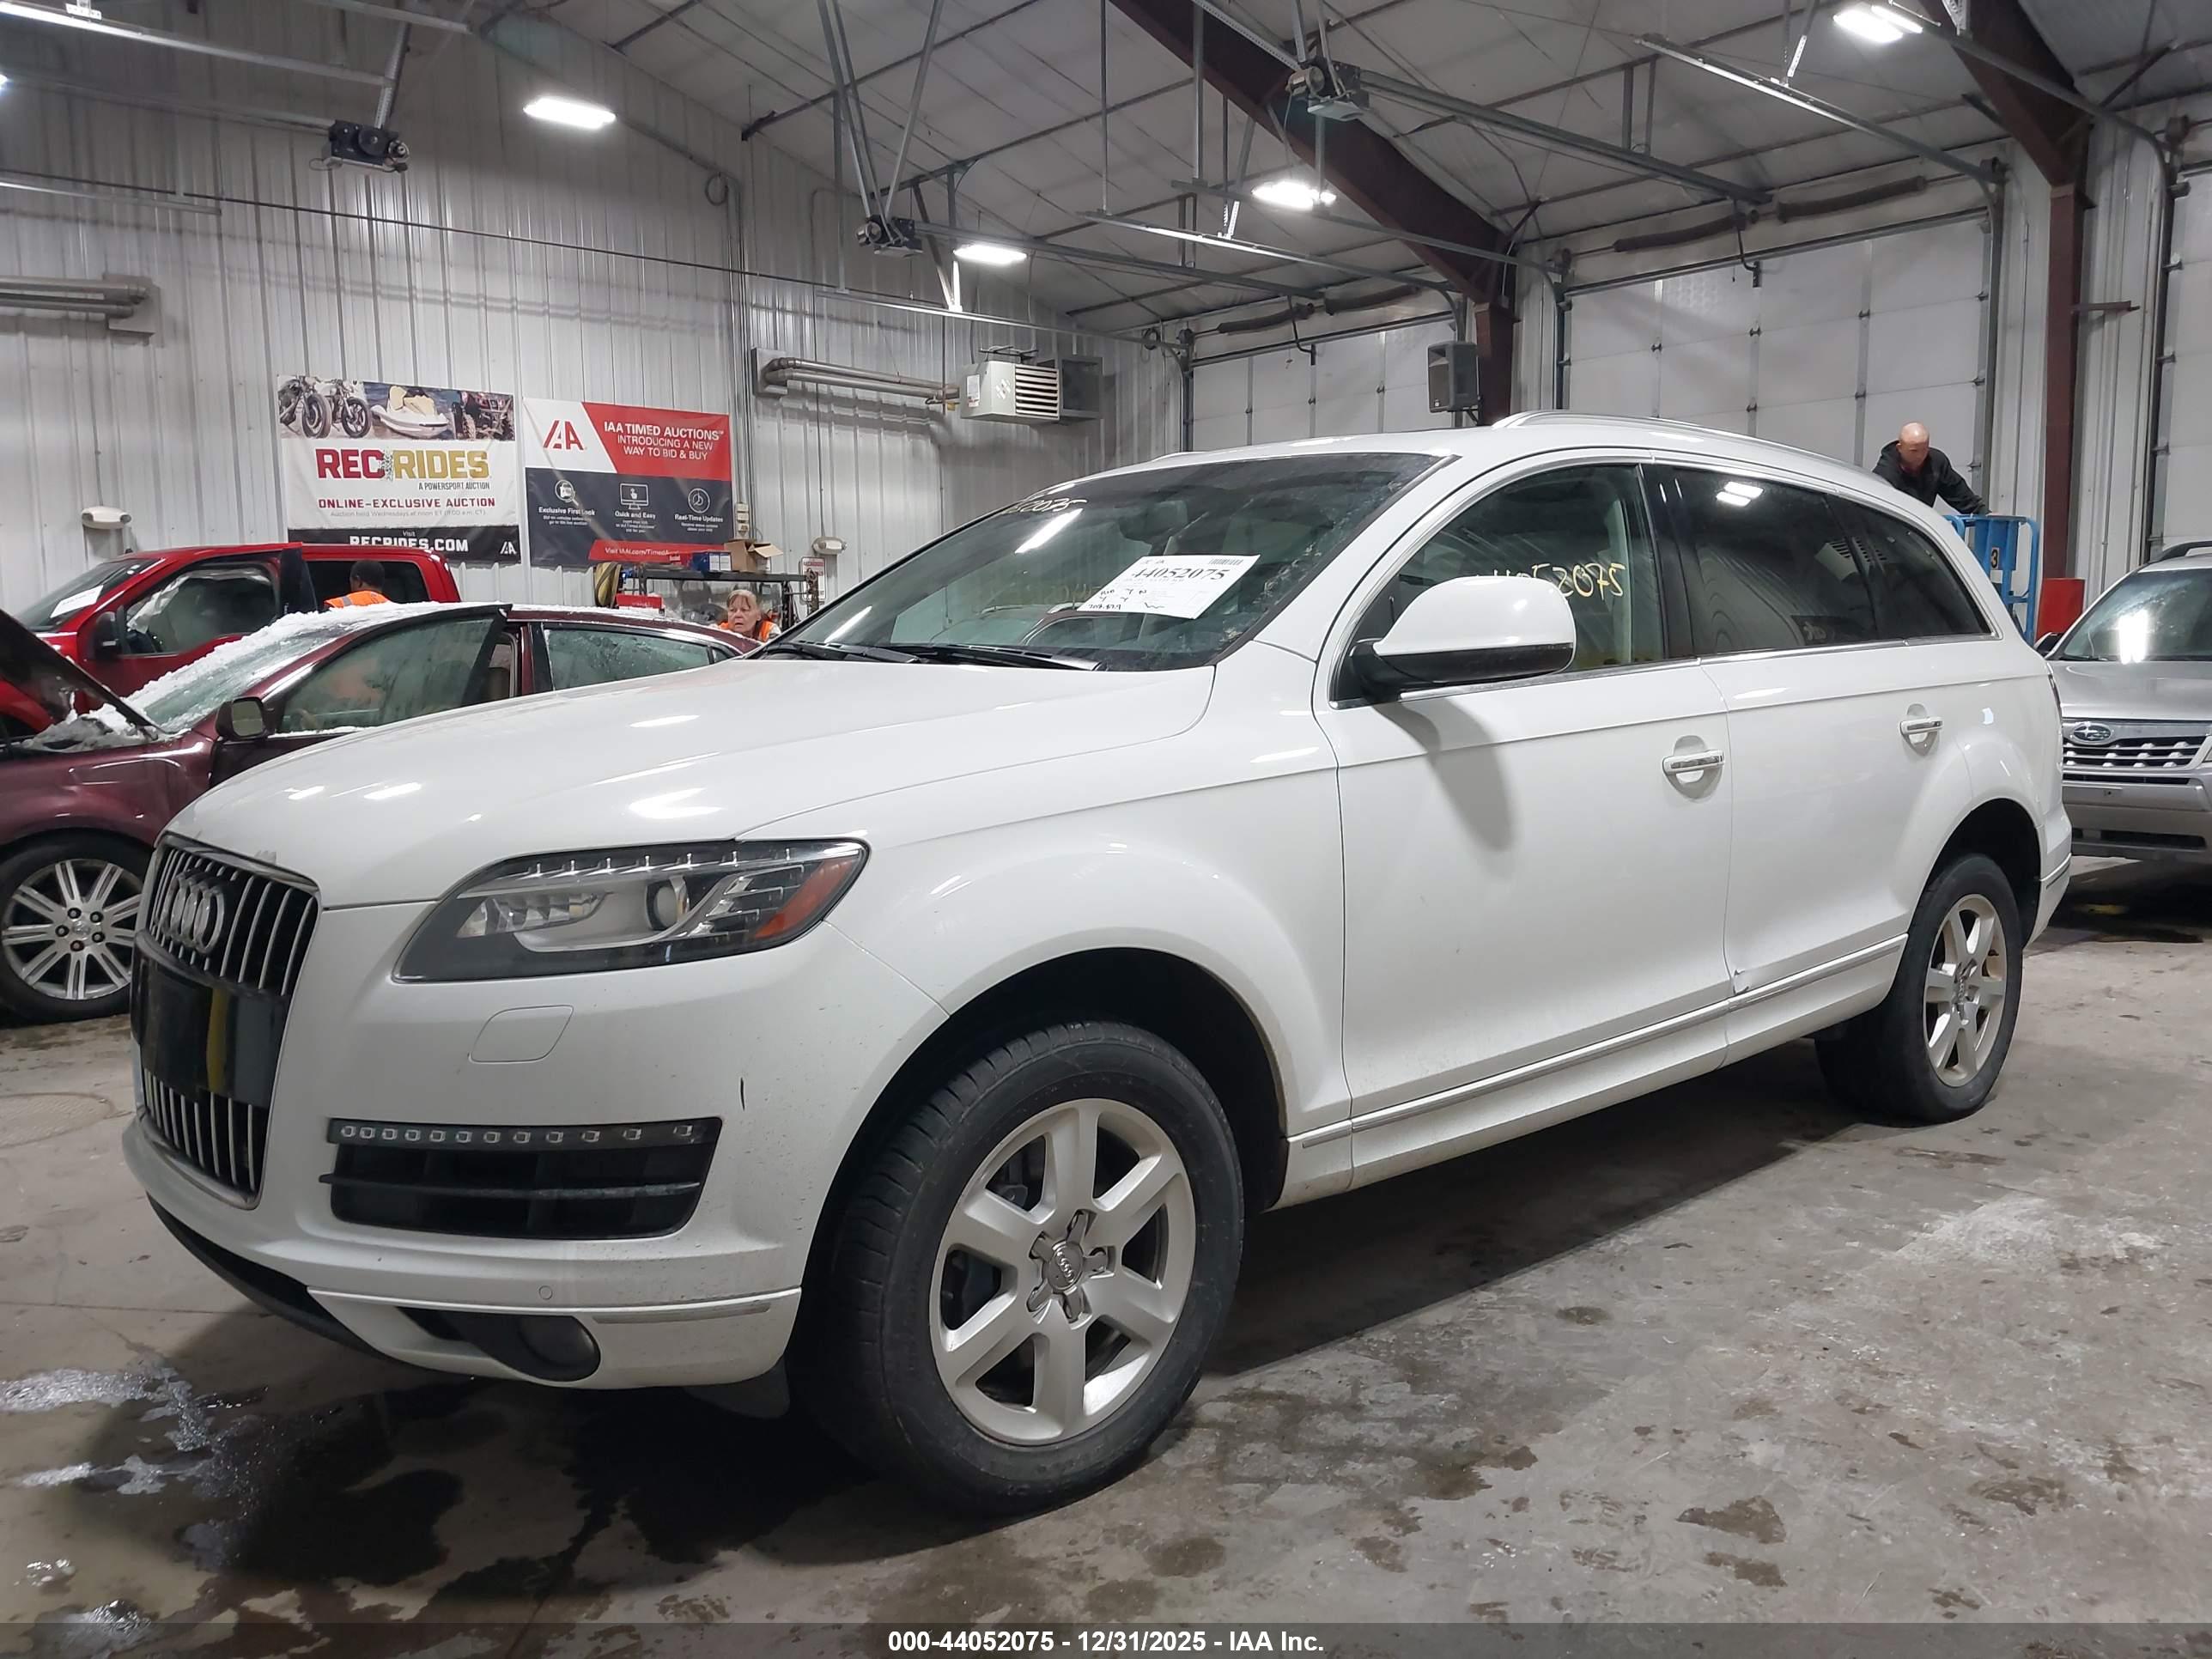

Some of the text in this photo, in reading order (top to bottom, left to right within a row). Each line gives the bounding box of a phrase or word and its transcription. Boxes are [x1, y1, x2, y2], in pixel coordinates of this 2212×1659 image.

[604, 421, 624, 434] IAA
[624, 422, 661, 436] TIMED
[617, 434, 714, 451] INTRODUCING A NEW
[623, 445, 708, 461] WAY TO BID & BUY
[315, 448, 490, 480] REC RIDES
[424, 482, 465, 490] POWERSPORT
[465, 482, 490, 490] AUCTION
[318, 497, 495, 509] ONLINE-EXCLUSIVE AUCTION
[642, 512, 656, 520] Easy
[402, 528, 416, 538] Visit
[1990, 548, 1999, 570] 3
[1131, 567, 1231, 580] 44052075
